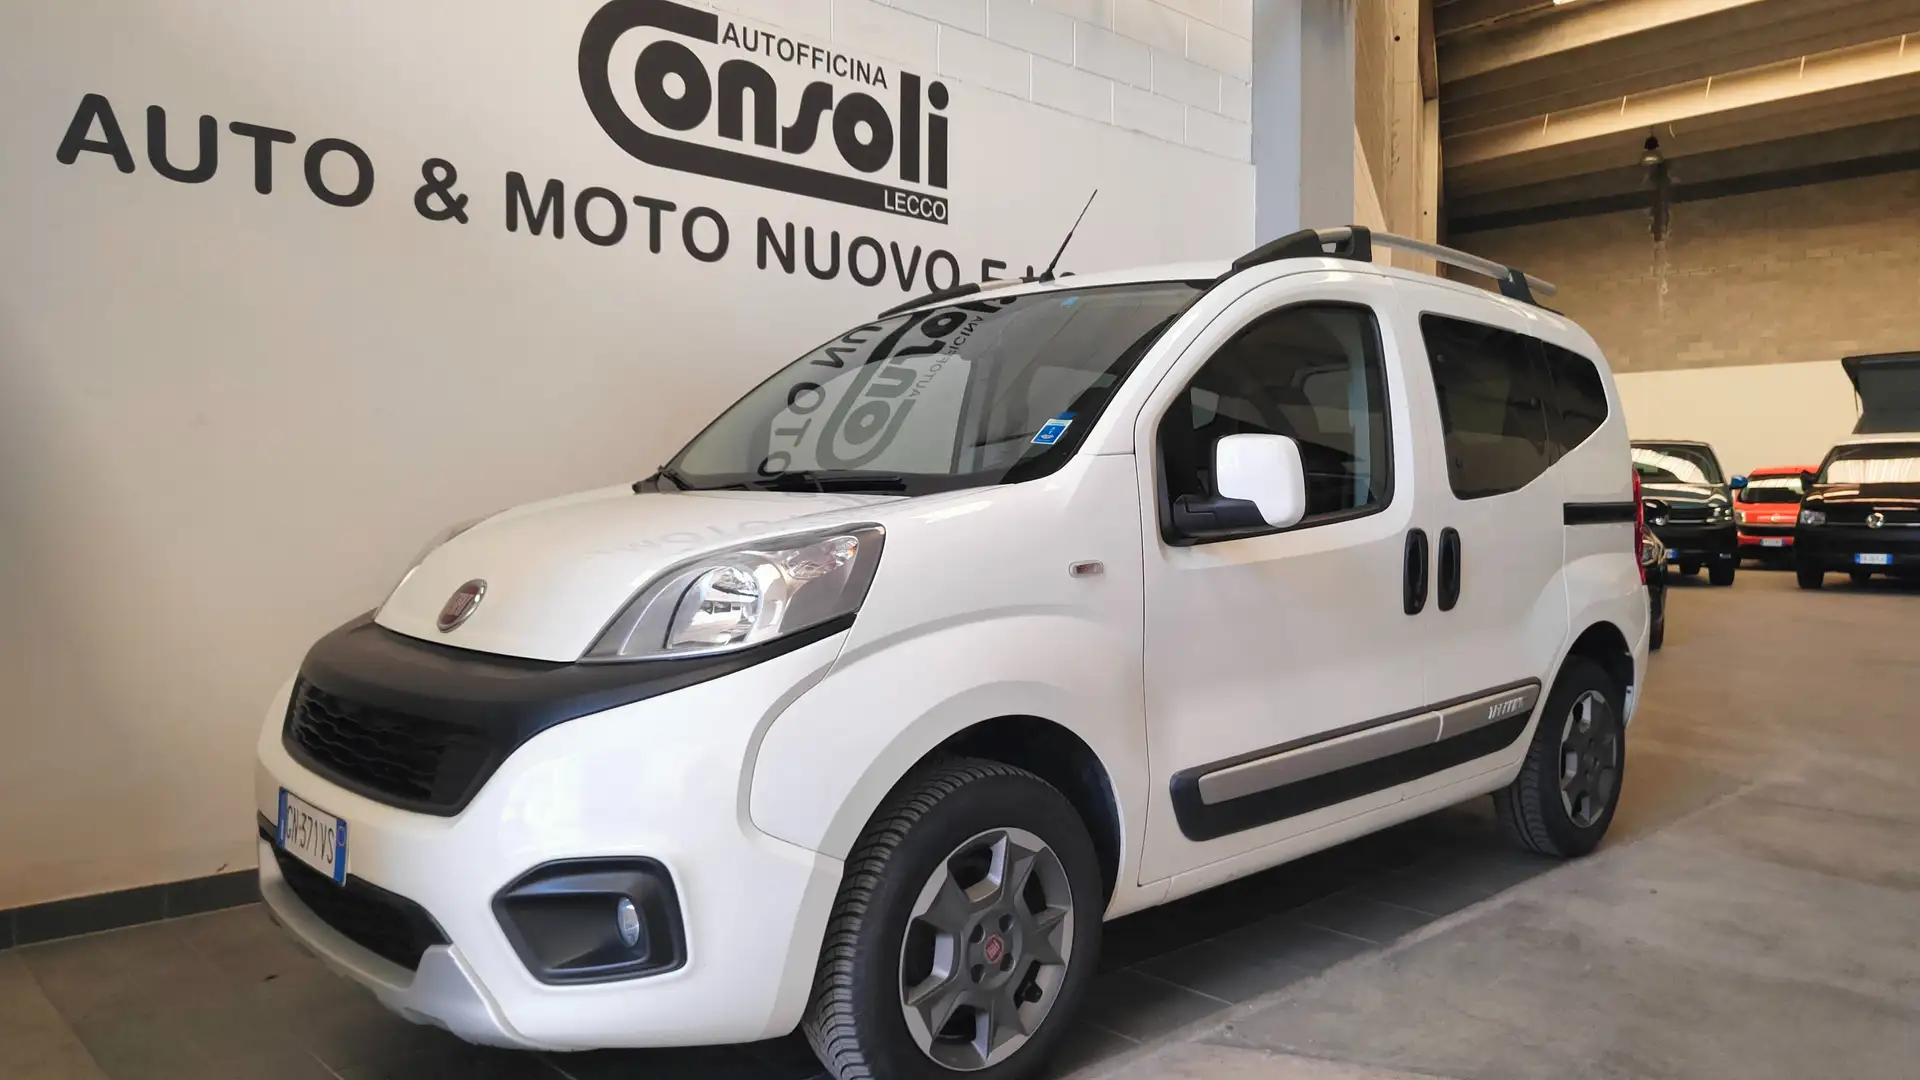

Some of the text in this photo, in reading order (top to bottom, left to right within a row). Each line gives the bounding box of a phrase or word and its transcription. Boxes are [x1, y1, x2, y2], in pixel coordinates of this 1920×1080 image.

[721, 22, 888, 90] AUTOFFICINA
[56, 93, 375, 208] AUTO
[413, 157, 469, 225] &
[505, 171, 730, 263] MOTO
[756, 217, 960, 295] NUOVO
[884, 188, 947, 221] LECCO
